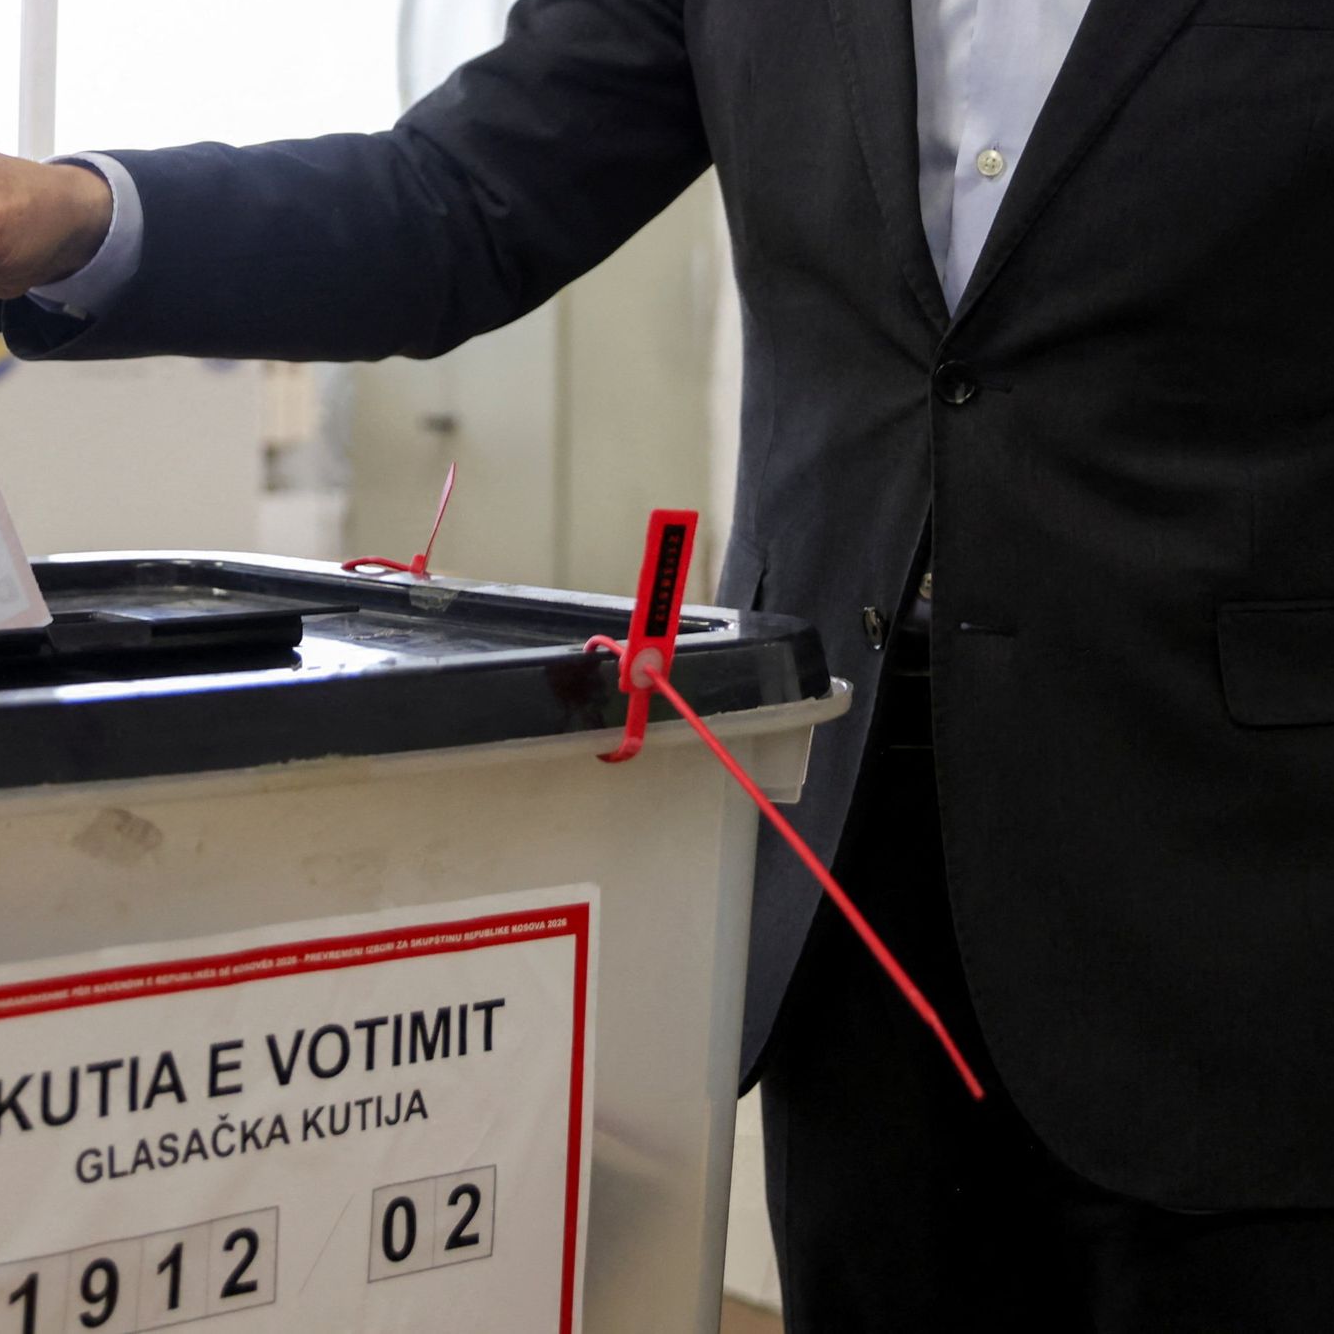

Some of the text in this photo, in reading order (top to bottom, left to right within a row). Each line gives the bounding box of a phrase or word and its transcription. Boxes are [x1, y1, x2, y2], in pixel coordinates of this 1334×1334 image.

[396, 940, 409, 949] ZA
[410, 933, 462, 948] SKUPŠTINU
[511, 920, 546, 933] KOSOVA
[207, 1039, 245, 1098] E
[265, 997, 505, 1087] VOTIMIT
[75, 1089, 428, 1184] GLASAČKA KUTIJA
[8, 1182, 481, 1334] 1912 02
